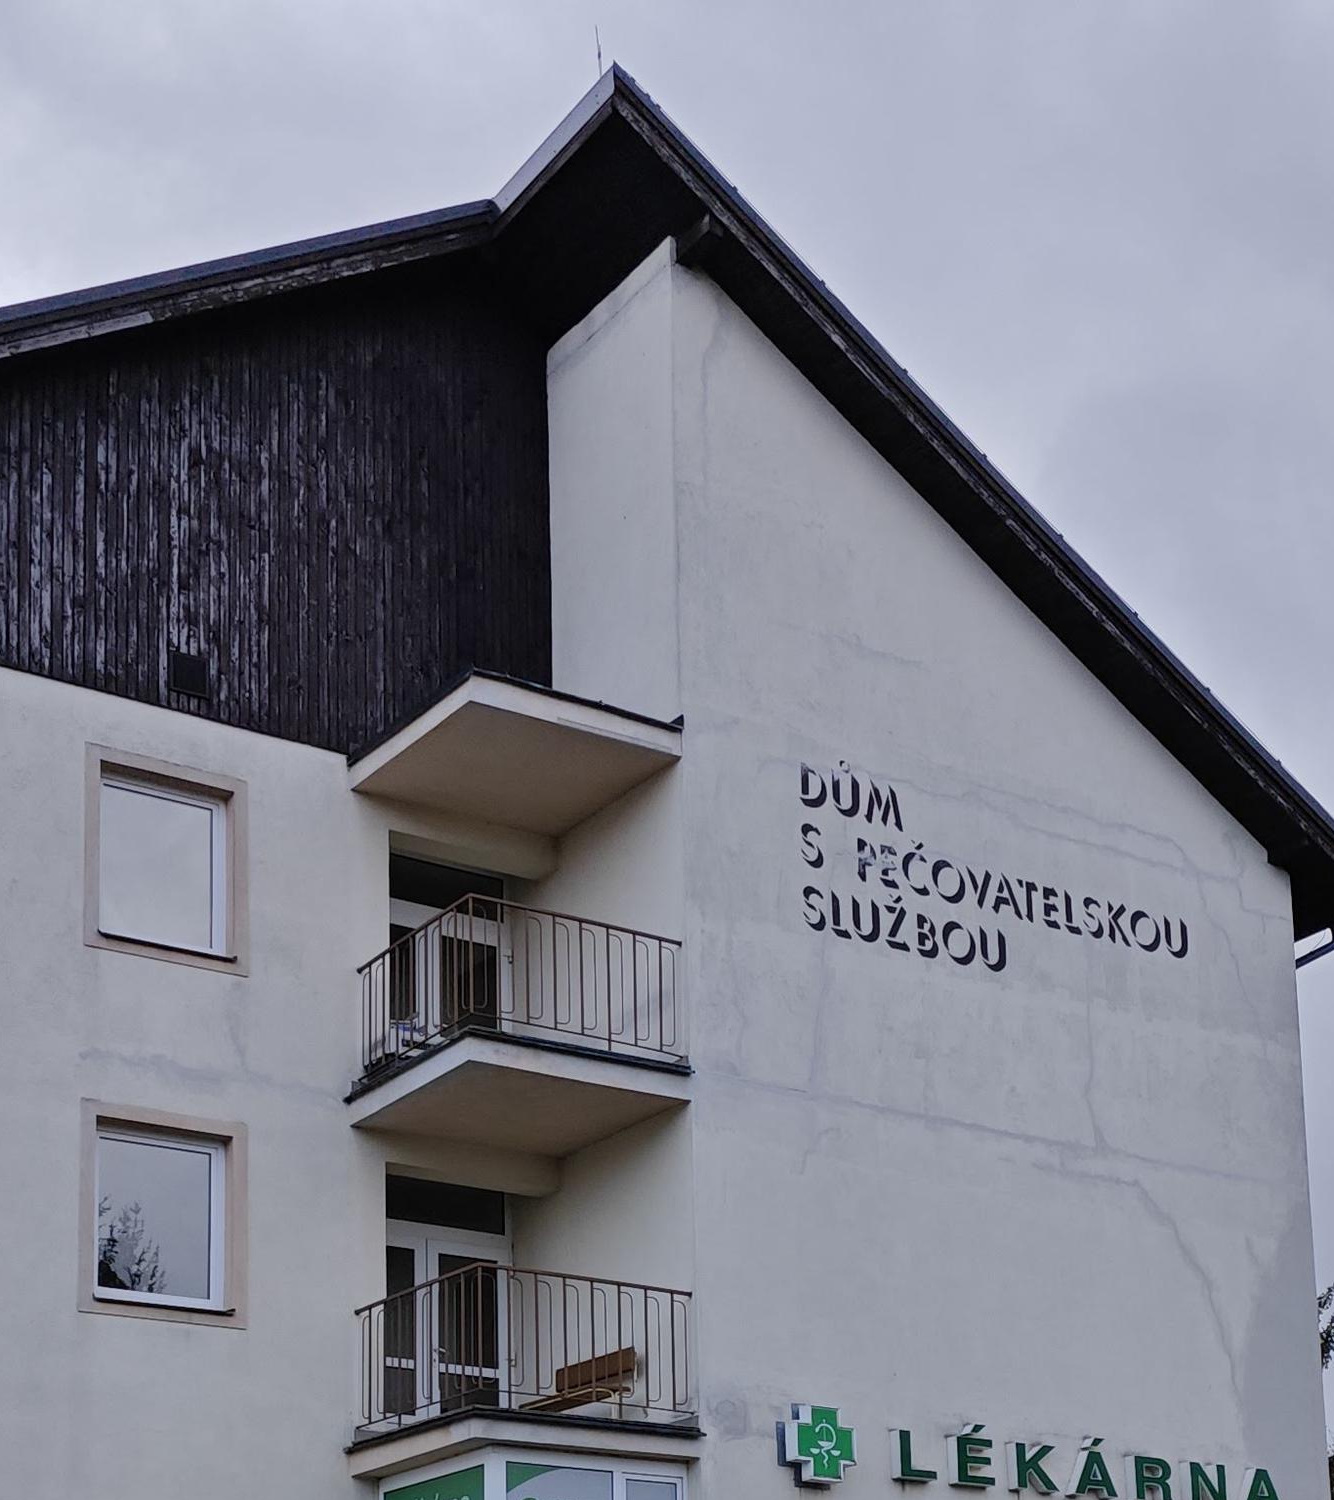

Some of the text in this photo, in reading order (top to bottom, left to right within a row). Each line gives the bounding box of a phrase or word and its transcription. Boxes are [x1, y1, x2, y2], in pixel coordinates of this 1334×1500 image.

[799, 760, 904, 832] DŮM
[801, 823, 1189, 959] S PEČOVATELSKOU
[802, 885, 1008, 973] SLUŽBOU
